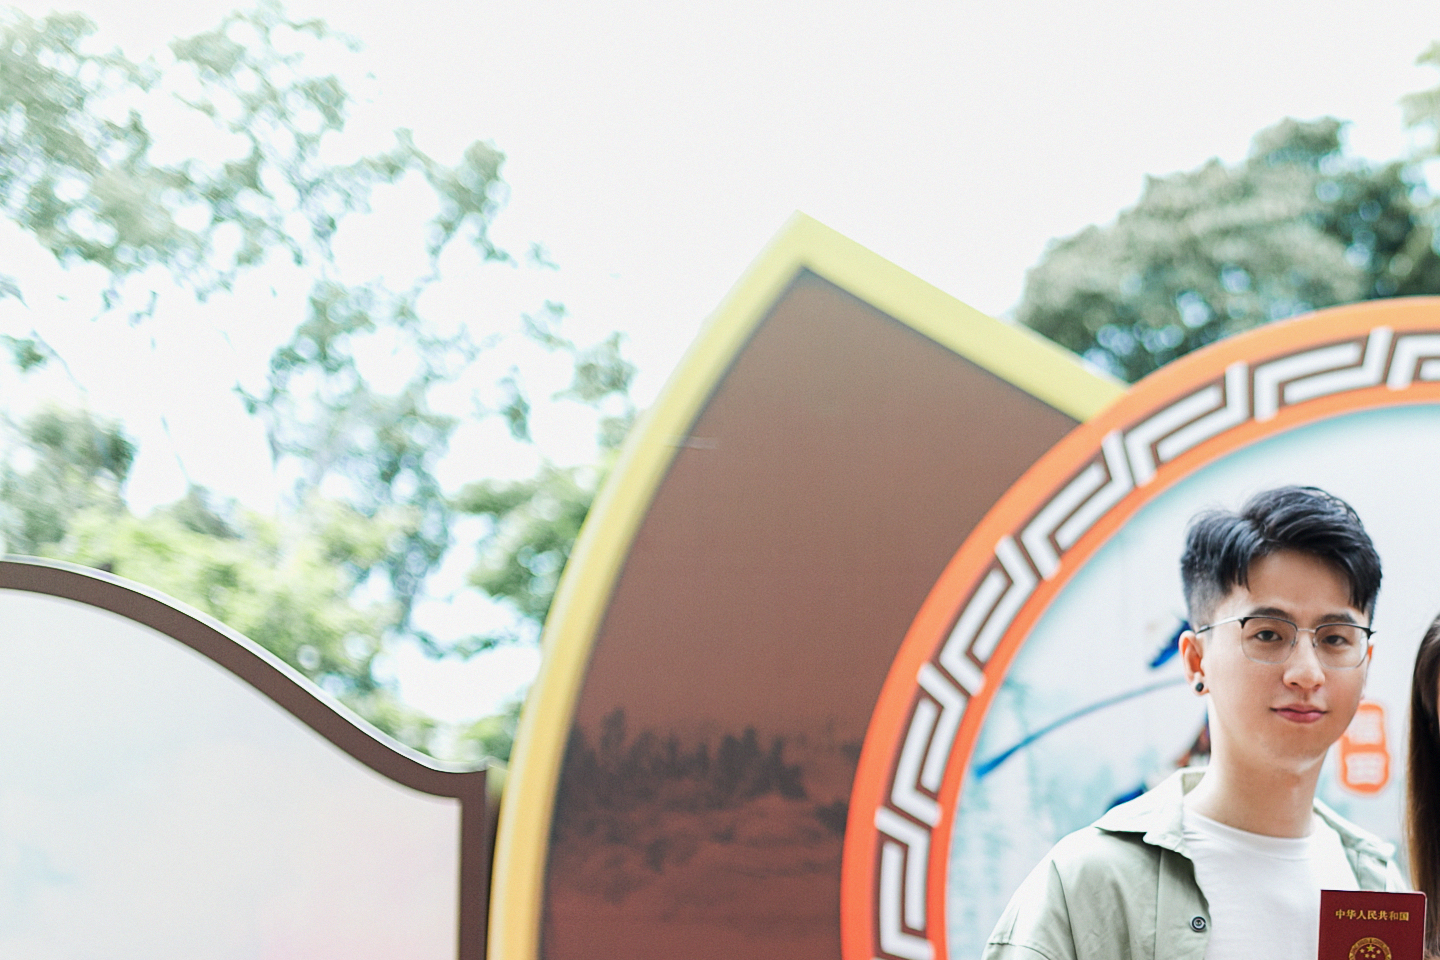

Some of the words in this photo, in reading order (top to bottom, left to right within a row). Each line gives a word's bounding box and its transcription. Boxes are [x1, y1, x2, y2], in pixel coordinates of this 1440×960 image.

[1335, 908, 1409, 921] 中华人民共和国
